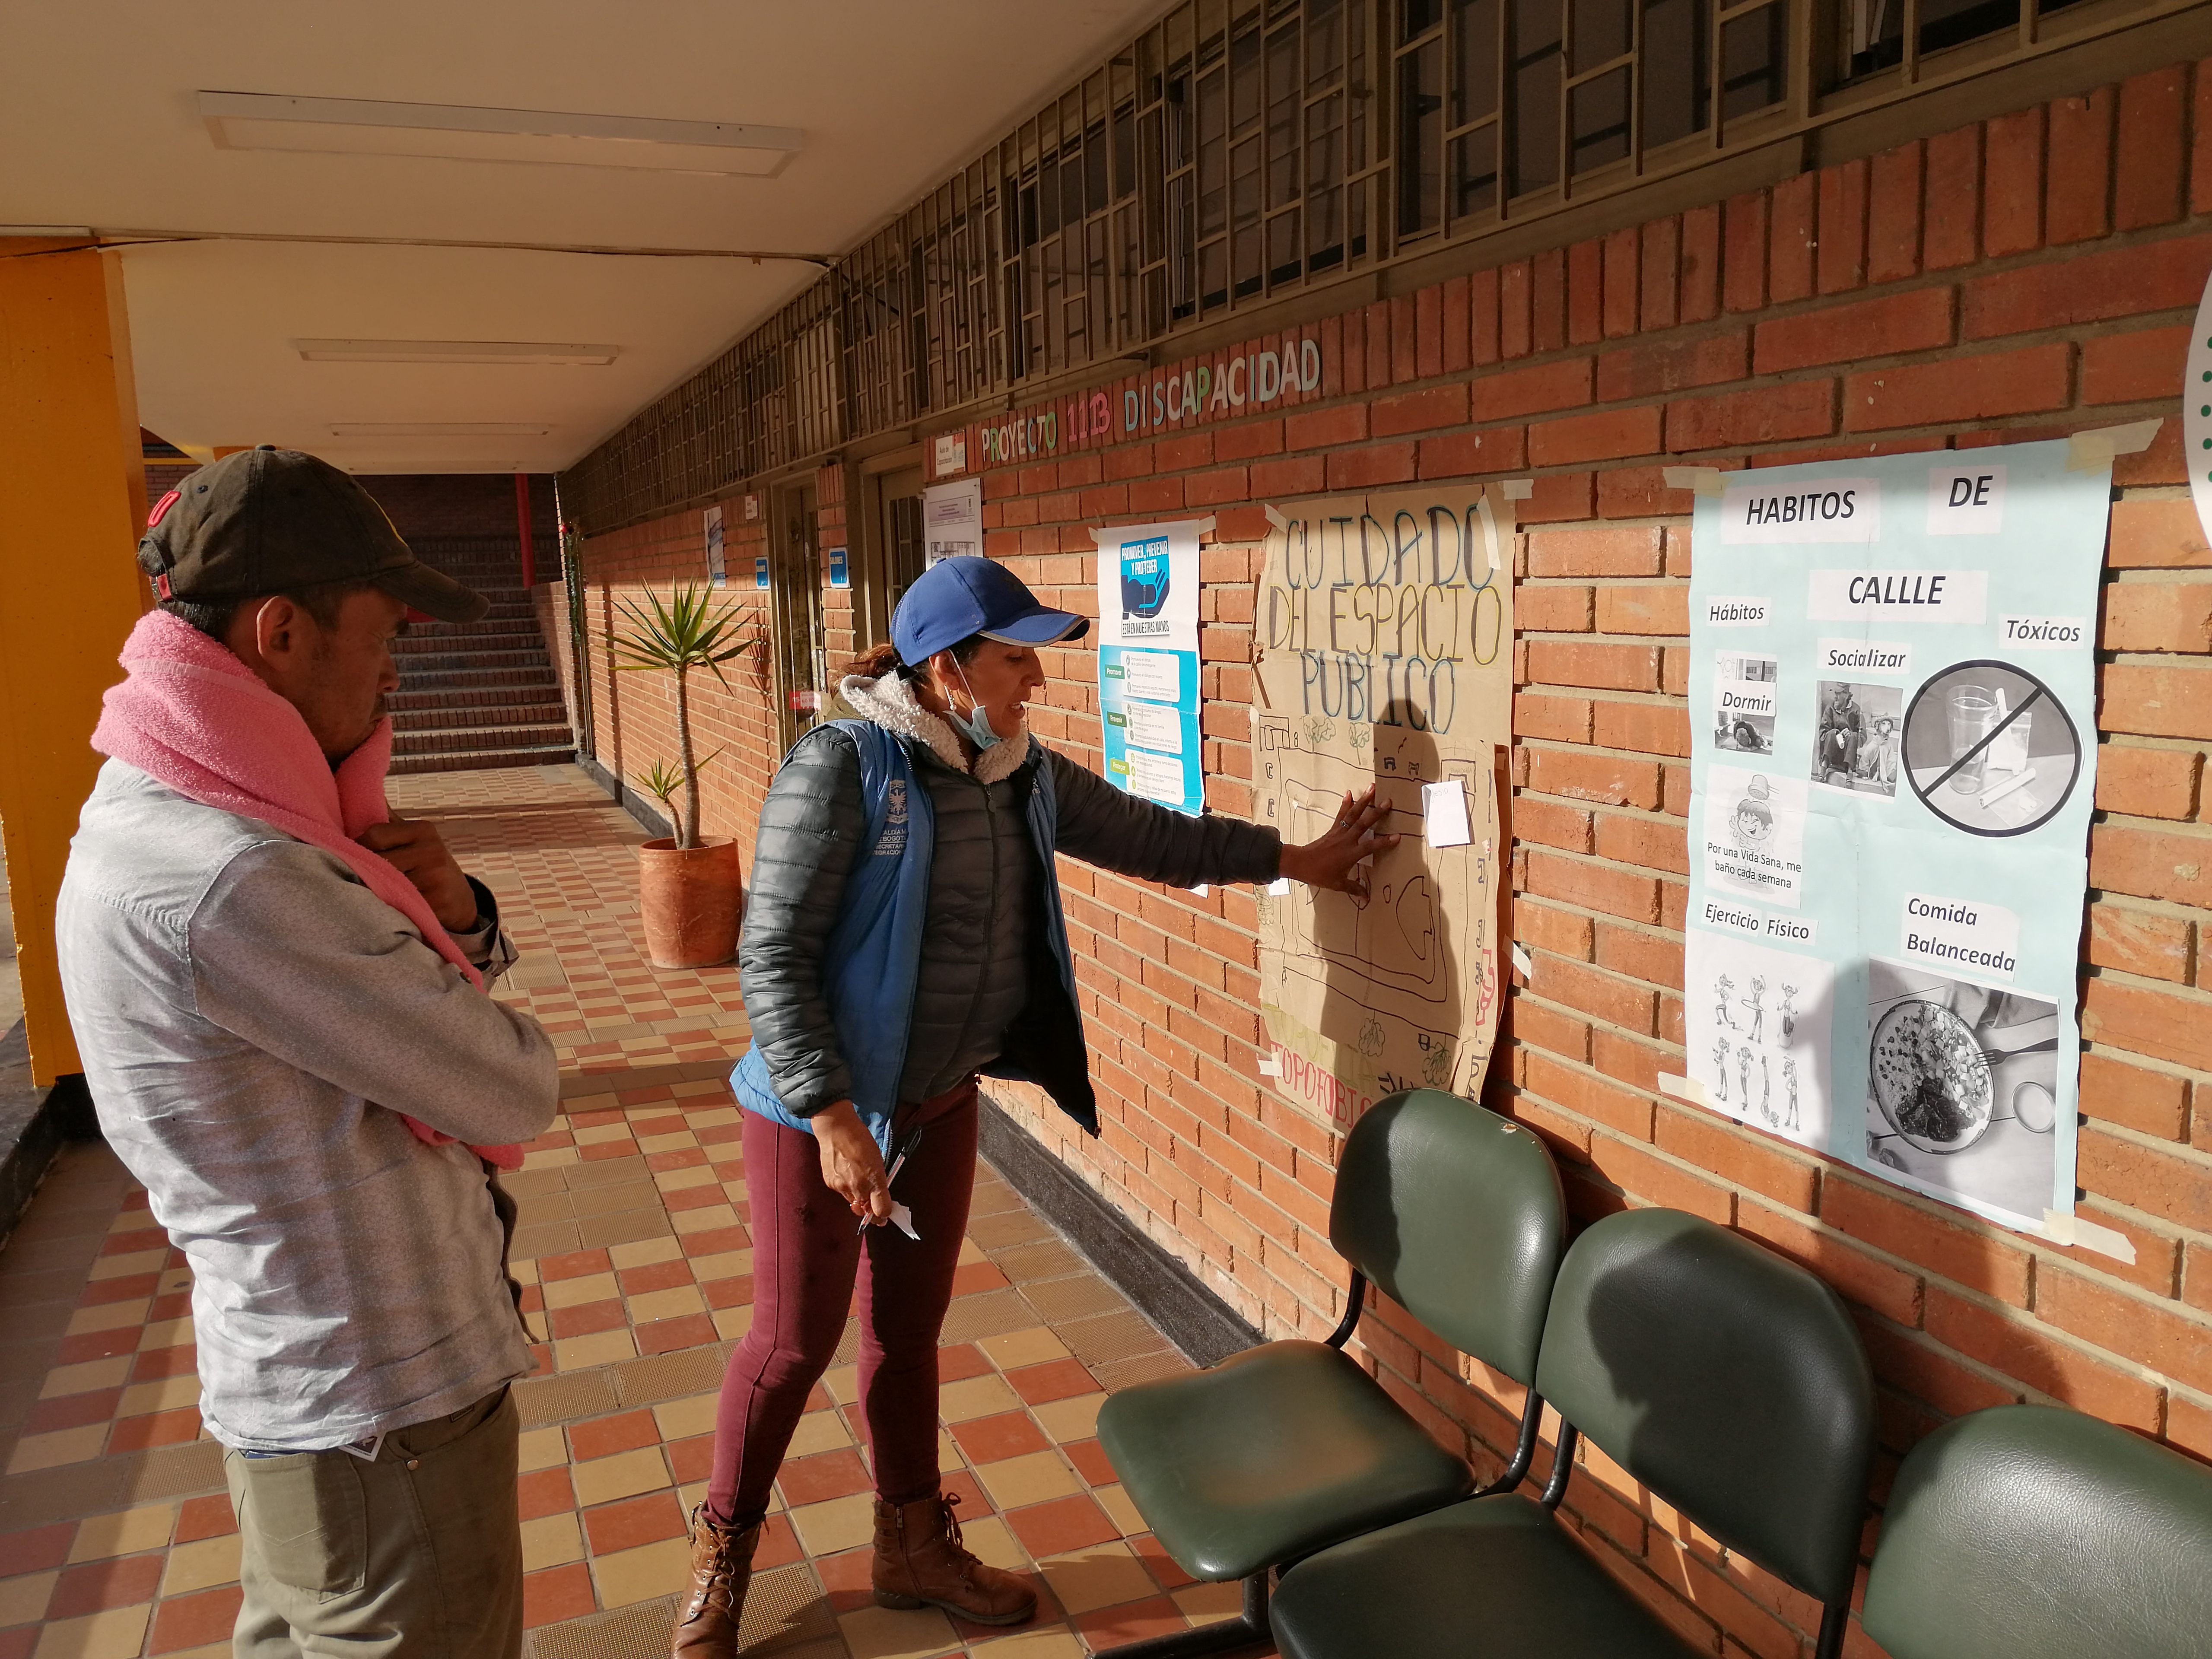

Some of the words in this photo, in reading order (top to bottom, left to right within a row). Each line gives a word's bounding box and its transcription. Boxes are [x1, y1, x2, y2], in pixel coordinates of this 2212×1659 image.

[981, 411, 1056, 462] PROYECTO
[1068, 392, 1111, 442] 1113
[1124, 339, 1320, 432] DISCAPACIDAD
[1746, 490, 1855, 525] HABITOS
[1948, 475, 1993, 507] DE
[1147, 540, 1168, 557] PREVENIR
[1286, 505, 1495, 590] CUIDADO
[1131, 562, 1135, 575] Y
[1135, 559, 1157, 575] PROTEGER
[1849, 576, 1946, 604] CALLLE
[1269, 584, 1316, 653] DEL
[1330, 582, 1502, 665] ESPACIO
[1710, 604, 1764, 621] Hábitos
[1131, 623, 1135, 634] EN
[1136, 622, 1155, 633] NUESTRAS
[1156, 620, 1169, 632] MANOS
[2007, 619, 2080, 642] Tóxicos
[1828, 649, 1906, 667] Socializar
[1300, 651, 1455, 734] PUBLICO
[1722, 691, 1772, 712] Dormir
[1110, 715, 1122, 723] Prevenir
[1113, 762, 1126, 771] Proteger
[1707, 841, 1722, 855] Por
[1723, 848, 1738, 858] una
[1741, 848, 1759, 863] Vida
[1761, 854, 1784, 870] Sana,
[1786, 863, 1802, 873] me
[1715, 859, 1735, 876] baño
[1737, 868, 1756, 881] cada
[1758, 876, 1792, 889] semana
[1705, 904, 1759, 931] Ejercicio
[1767, 919, 1809, 939] Físico
[1908, 898, 1977, 926] Comida
[1907, 933, 2015, 972] Balanceada
